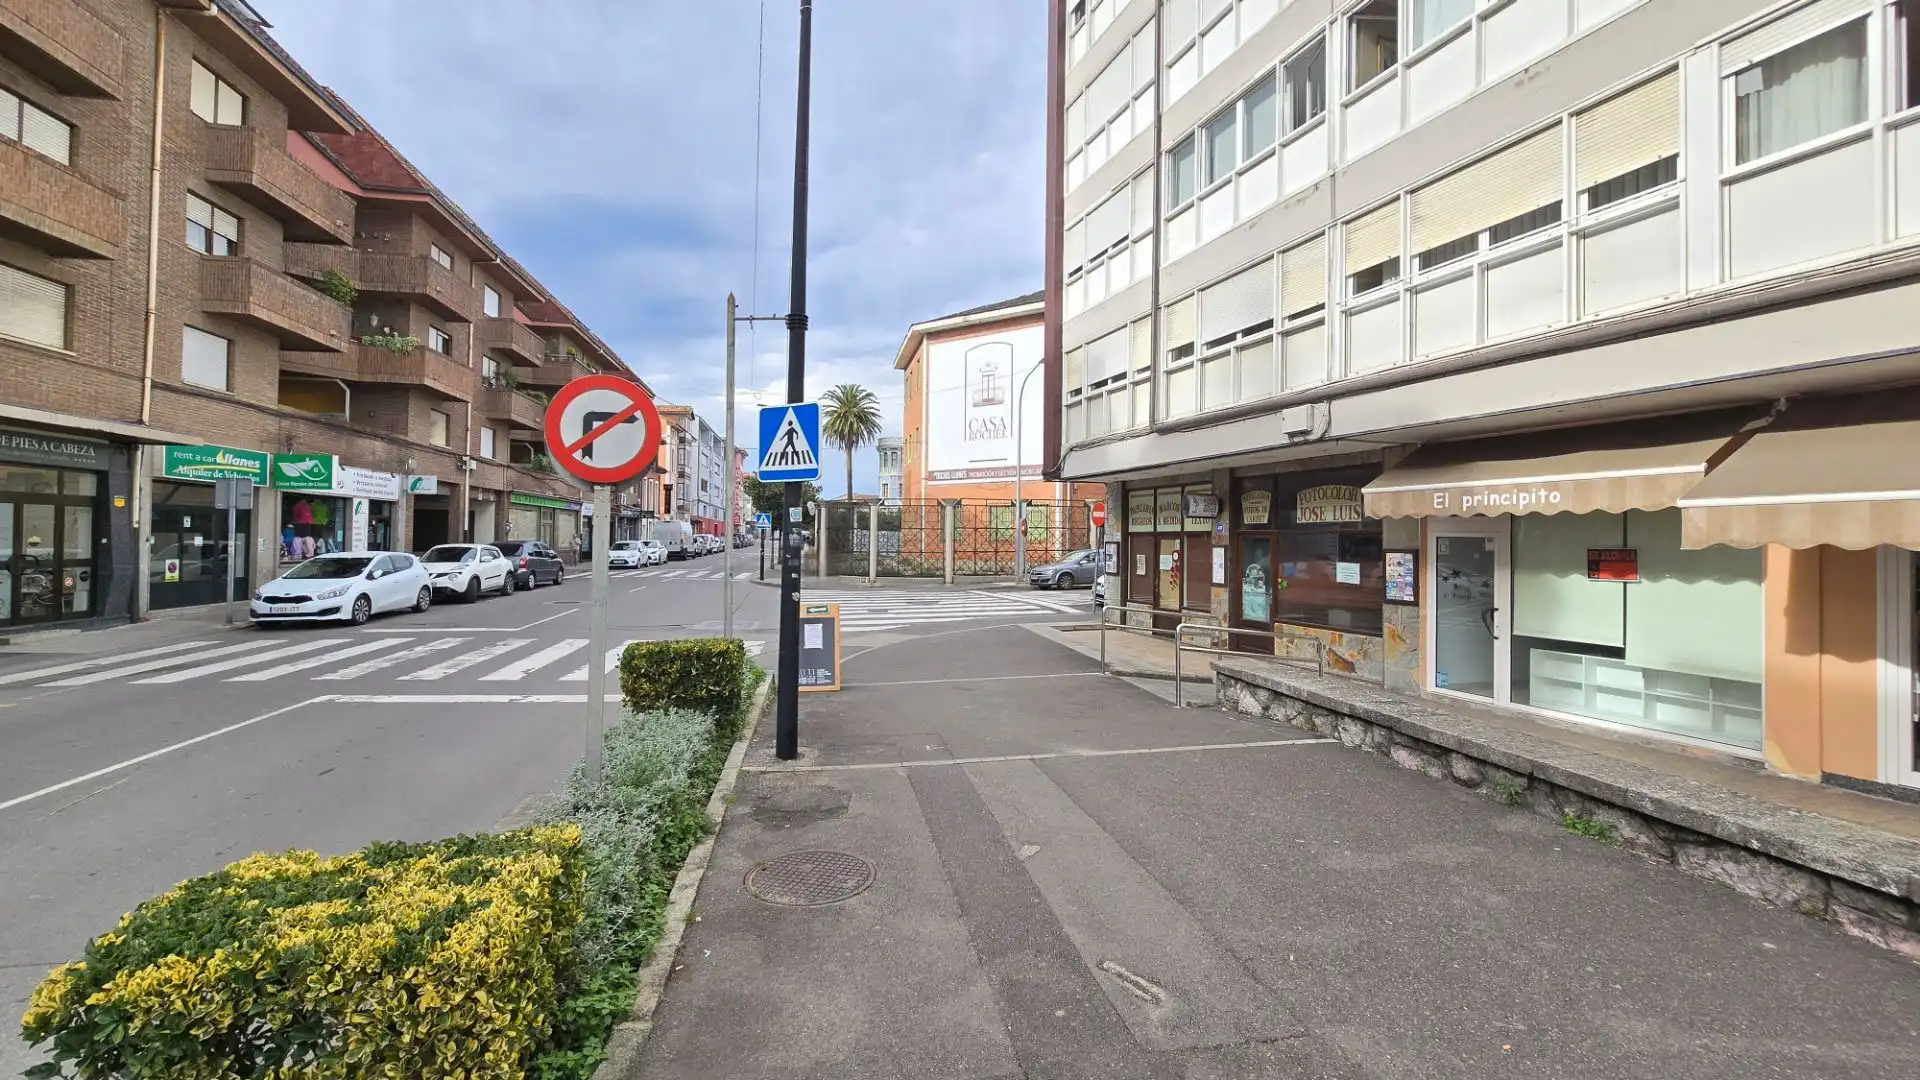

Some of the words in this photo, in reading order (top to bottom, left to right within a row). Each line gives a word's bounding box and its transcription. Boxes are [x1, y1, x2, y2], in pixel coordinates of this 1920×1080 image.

[968, 415, 1006, 432] CASA
[12, 436, 39, 449] PIES
[40, 441, 49, 451] A
[50, 441, 96, 456] CABEZA
[173, 451, 193, 460] rent
[202, 455, 215, 463] car
[178, 465, 212, 478] Alquiler
[213, 469, 223, 478] de
[1299, 486, 1357, 505] FOTOCOLOR
[1433, 492, 1449, 509] El
[1462, 488, 1561, 511] principito
[1297, 505, 1327, 522] JOSE
[1332, 503, 1361, 521] LUIS
